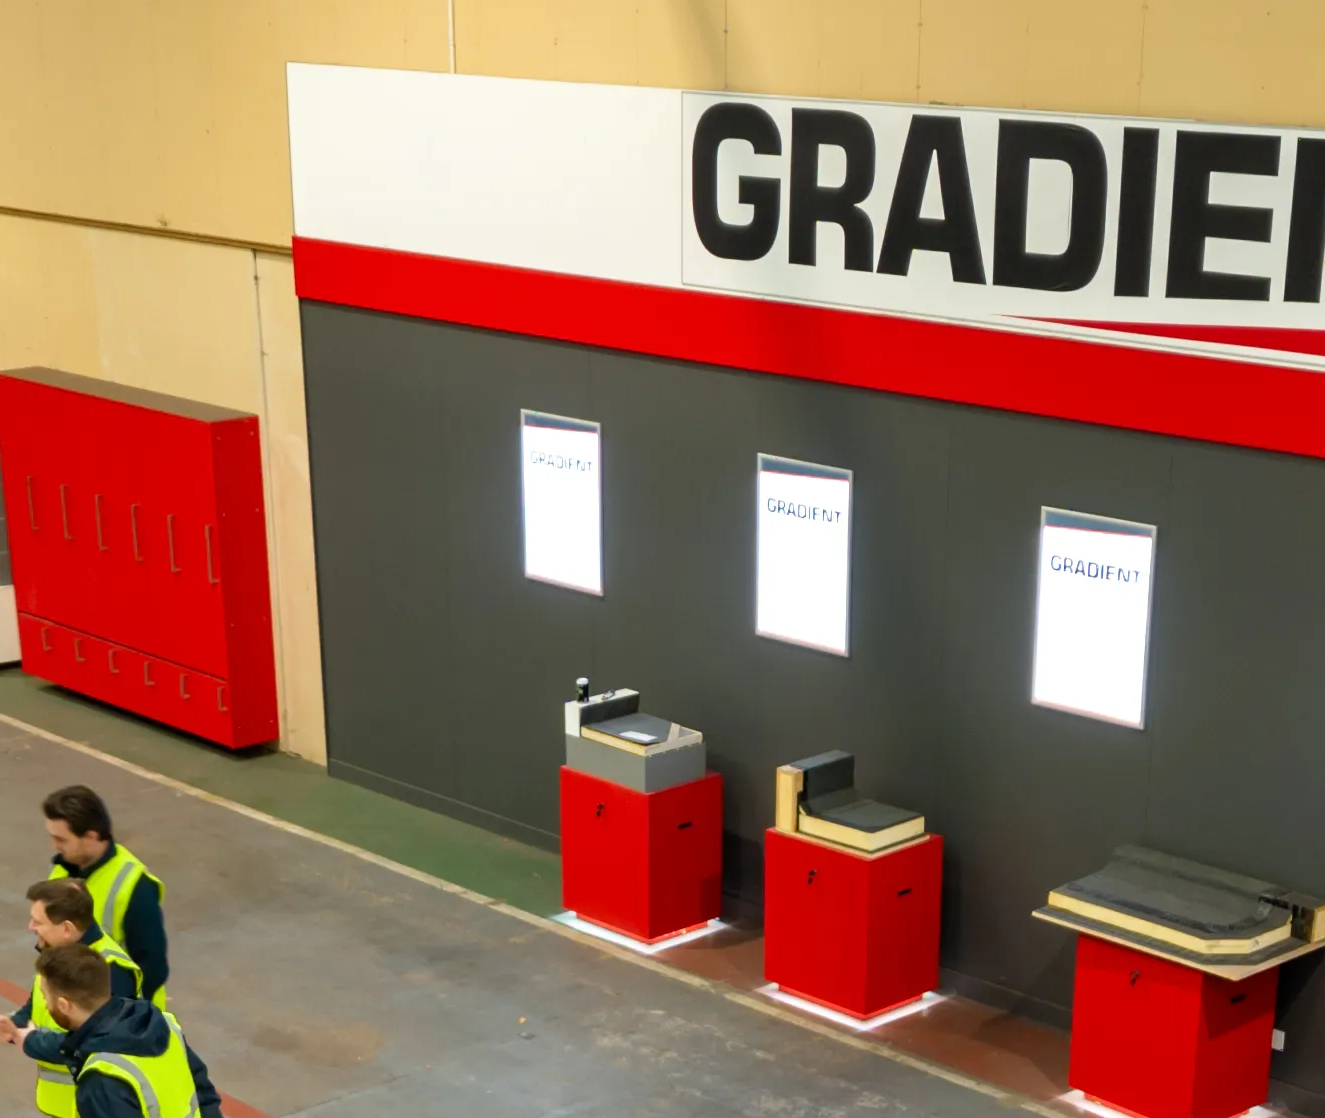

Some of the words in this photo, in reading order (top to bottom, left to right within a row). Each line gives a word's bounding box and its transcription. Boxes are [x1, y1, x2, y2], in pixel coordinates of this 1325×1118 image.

[530, 450, 593, 473] GRADIENT
[767, 497, 842, 524] GRADIENT
[1050, 554, 1141, 584] GRADIENT
